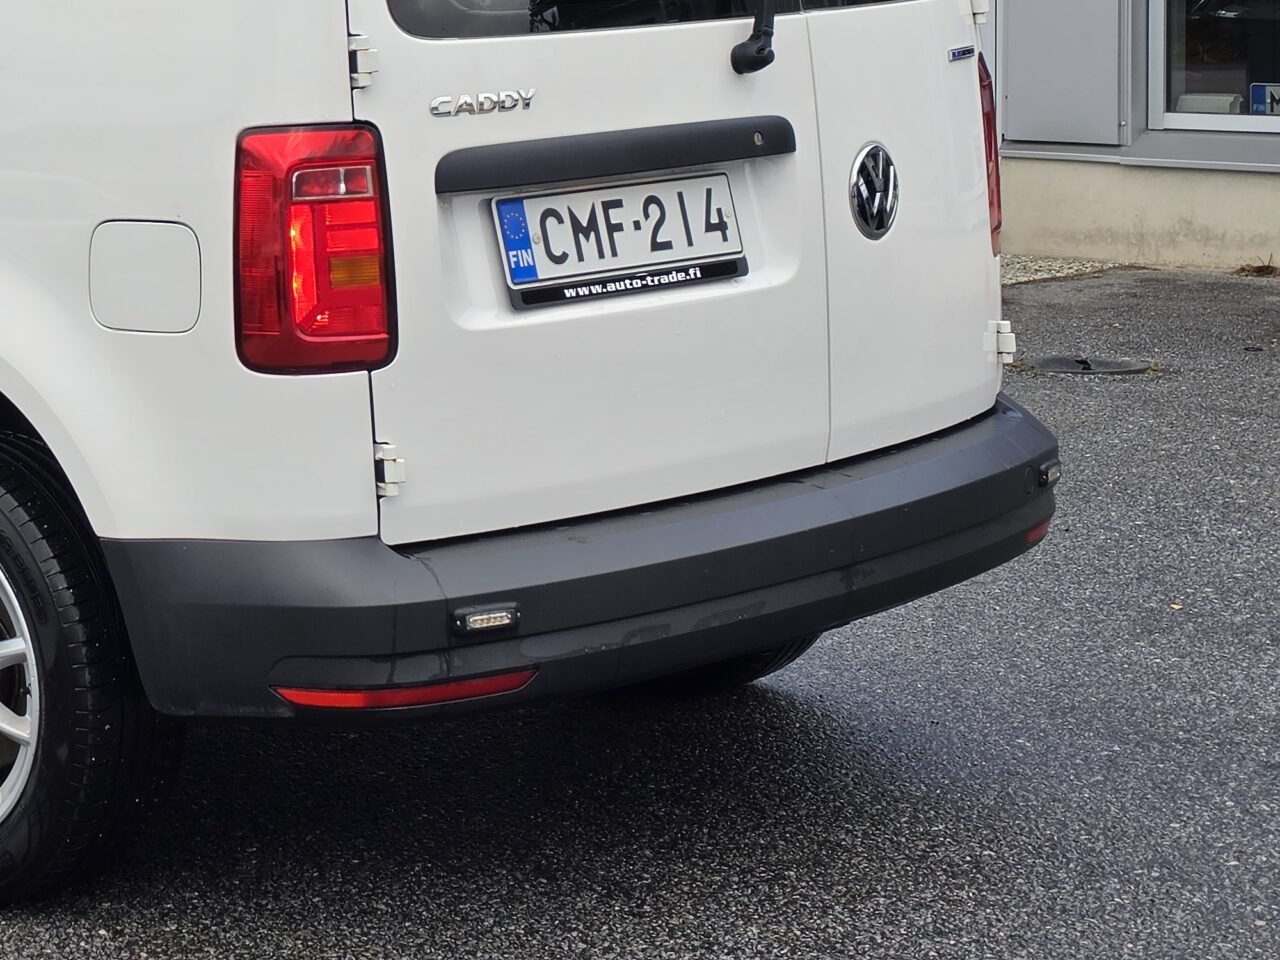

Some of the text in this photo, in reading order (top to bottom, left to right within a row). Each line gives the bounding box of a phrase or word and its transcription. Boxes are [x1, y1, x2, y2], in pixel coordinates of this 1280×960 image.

[429, 88, 536, 117] CADDY
[539, 188, 729, 264] CMF-214
[509, 248, 535, 269] FIN
[563, 267, 701, 298] www.auto-trade.fi
